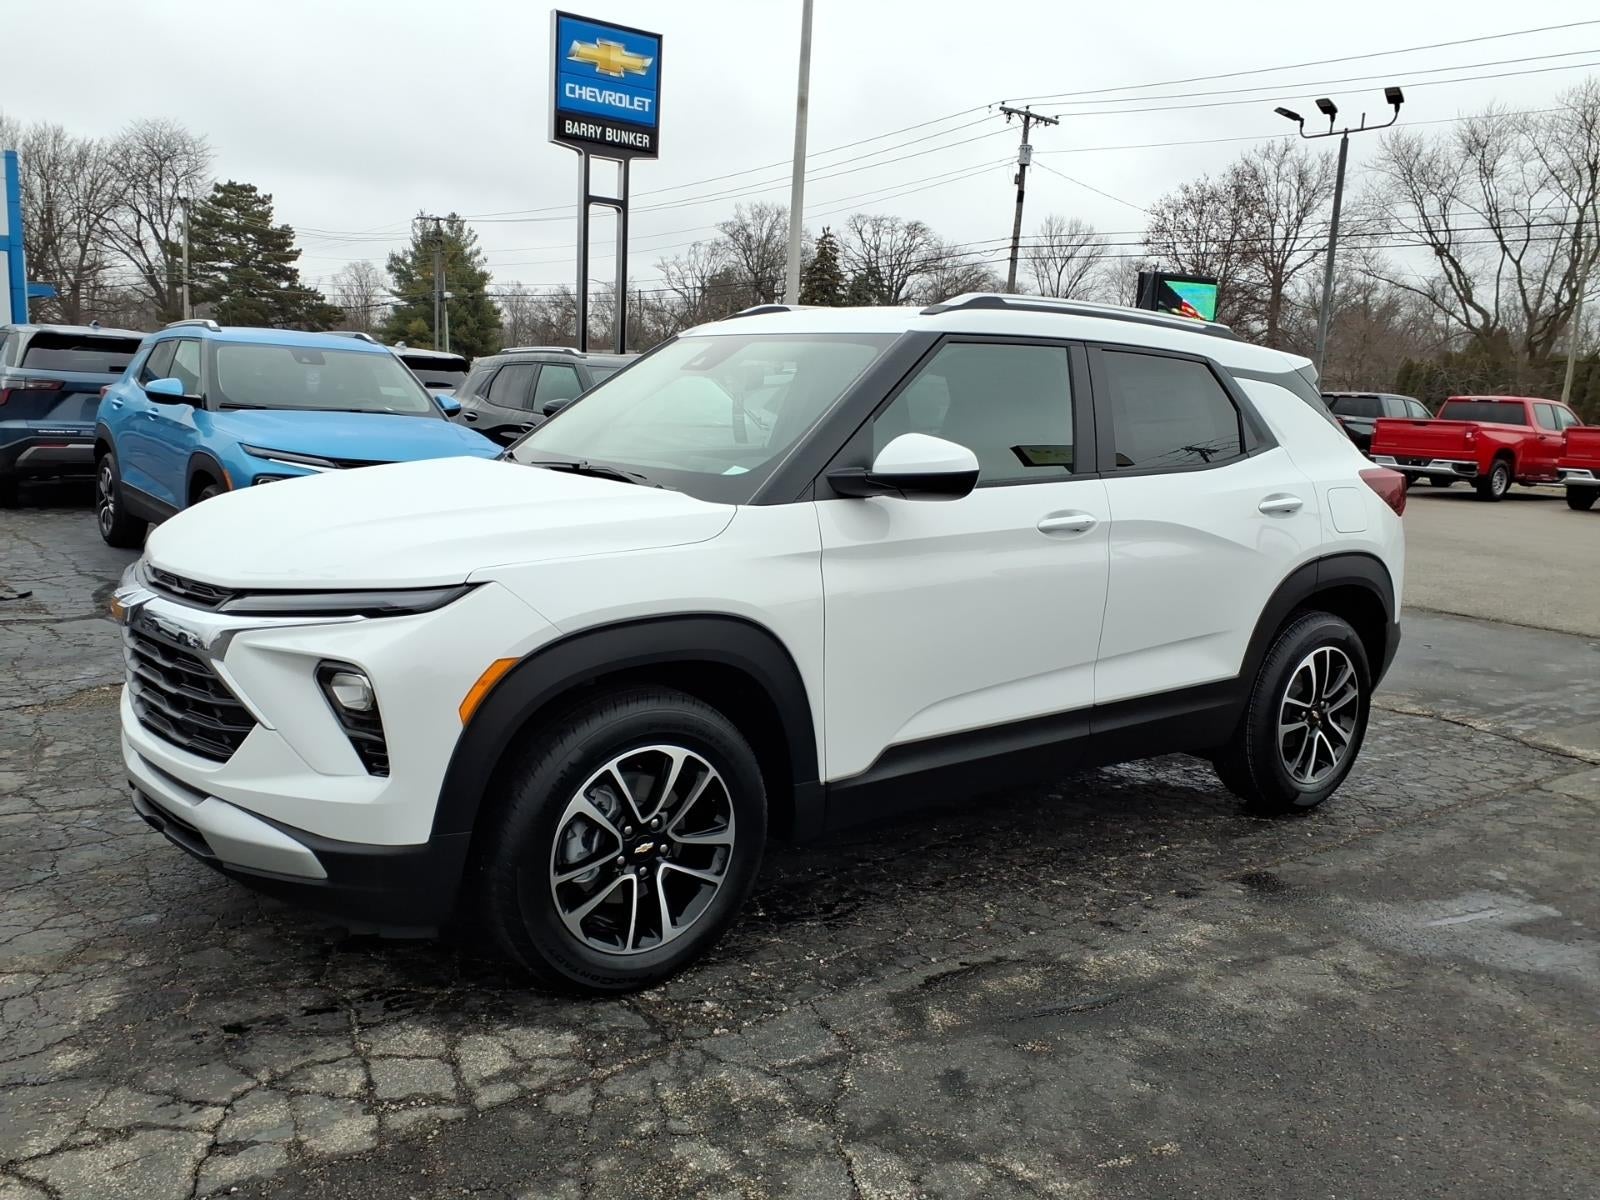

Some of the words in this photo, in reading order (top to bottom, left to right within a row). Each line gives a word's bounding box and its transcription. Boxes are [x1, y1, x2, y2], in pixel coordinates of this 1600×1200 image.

[566, 83, 651, 111] CHEVROLET
[565, 120, 602, 139] BARRY
[606, 128, 650, 148] BUNKER
